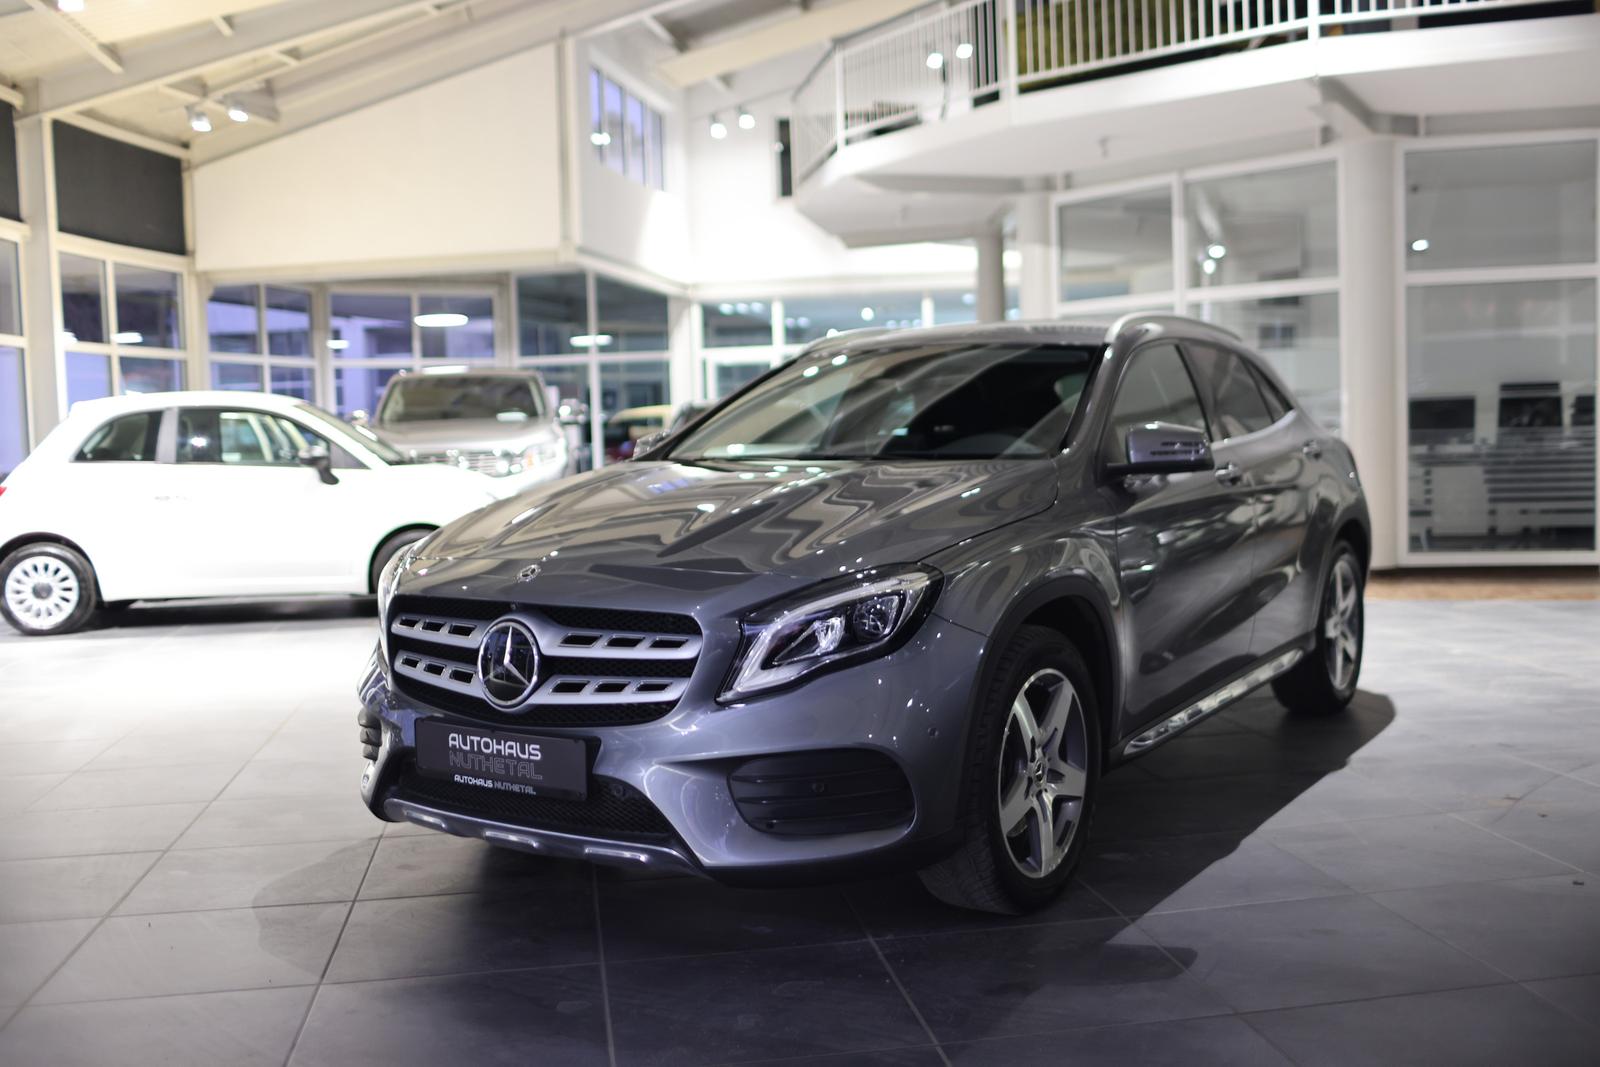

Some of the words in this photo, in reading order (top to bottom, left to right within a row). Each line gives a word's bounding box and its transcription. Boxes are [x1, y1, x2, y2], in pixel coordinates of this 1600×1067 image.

[448, 732, 542, 760] AUTOHAUS
[449, 750, 543, 780] NUTHETAL
[454, 774, 493, 788] AUTOHAUS
[494, 781, 537, 795] NUTHETAL
